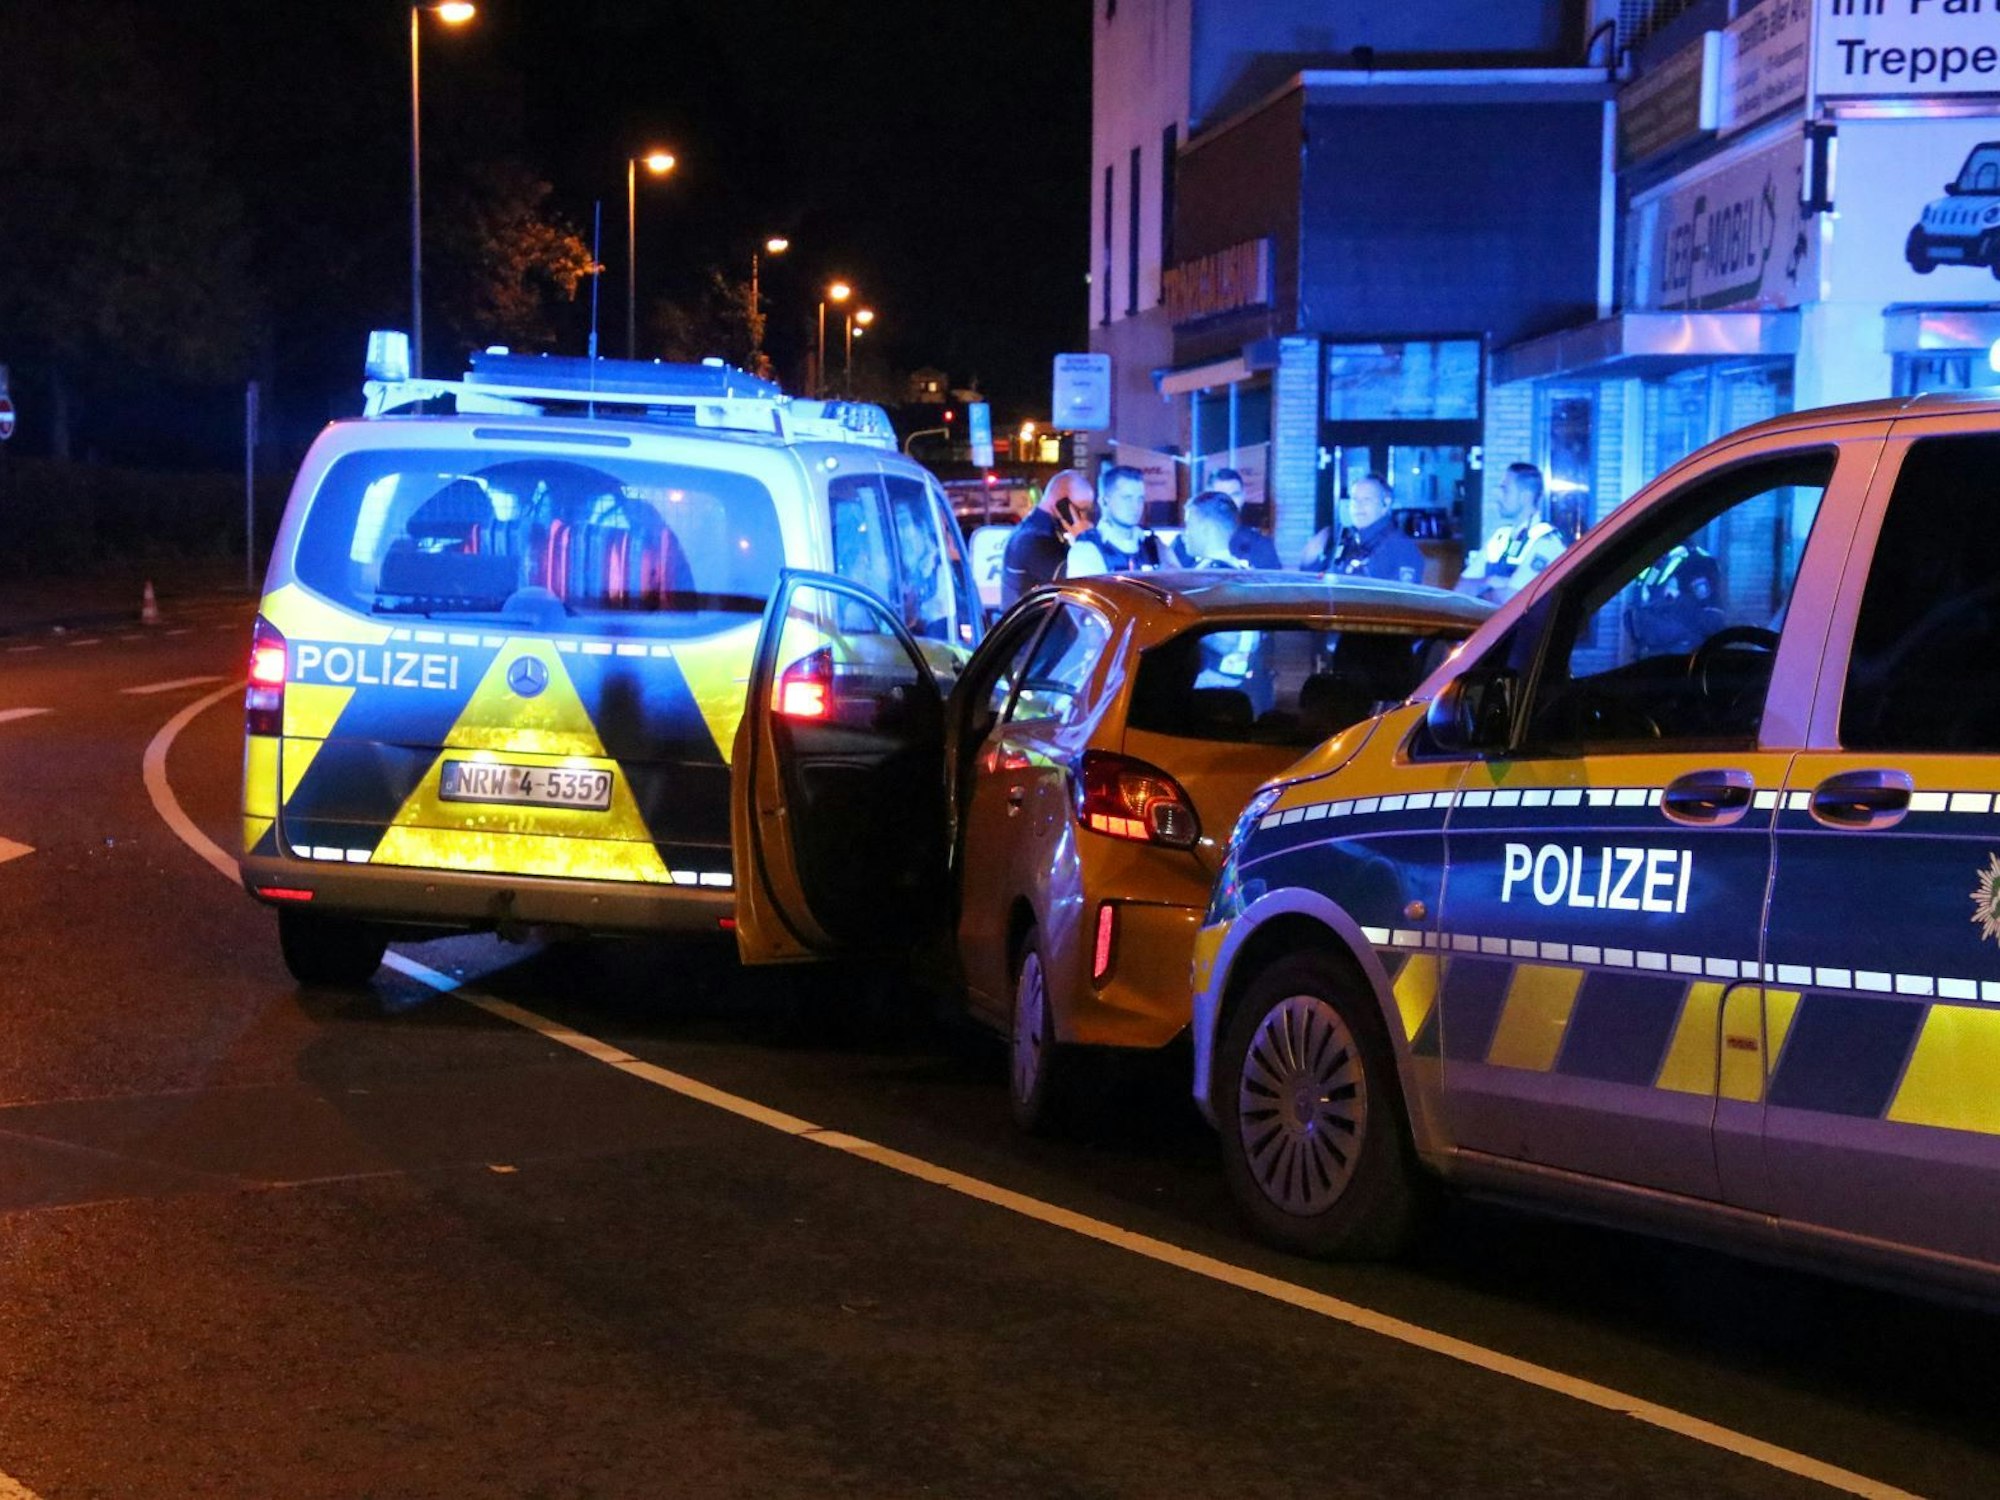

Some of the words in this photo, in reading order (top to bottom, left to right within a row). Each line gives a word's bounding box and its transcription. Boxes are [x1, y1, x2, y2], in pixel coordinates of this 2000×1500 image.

[1836, 38, 1998, 83] Treppe
[296, 644, 459, 690] POLIZEI
[457, 766, 507, 795] NRW
[1501, 843, 1693, 913] POLIZEI
